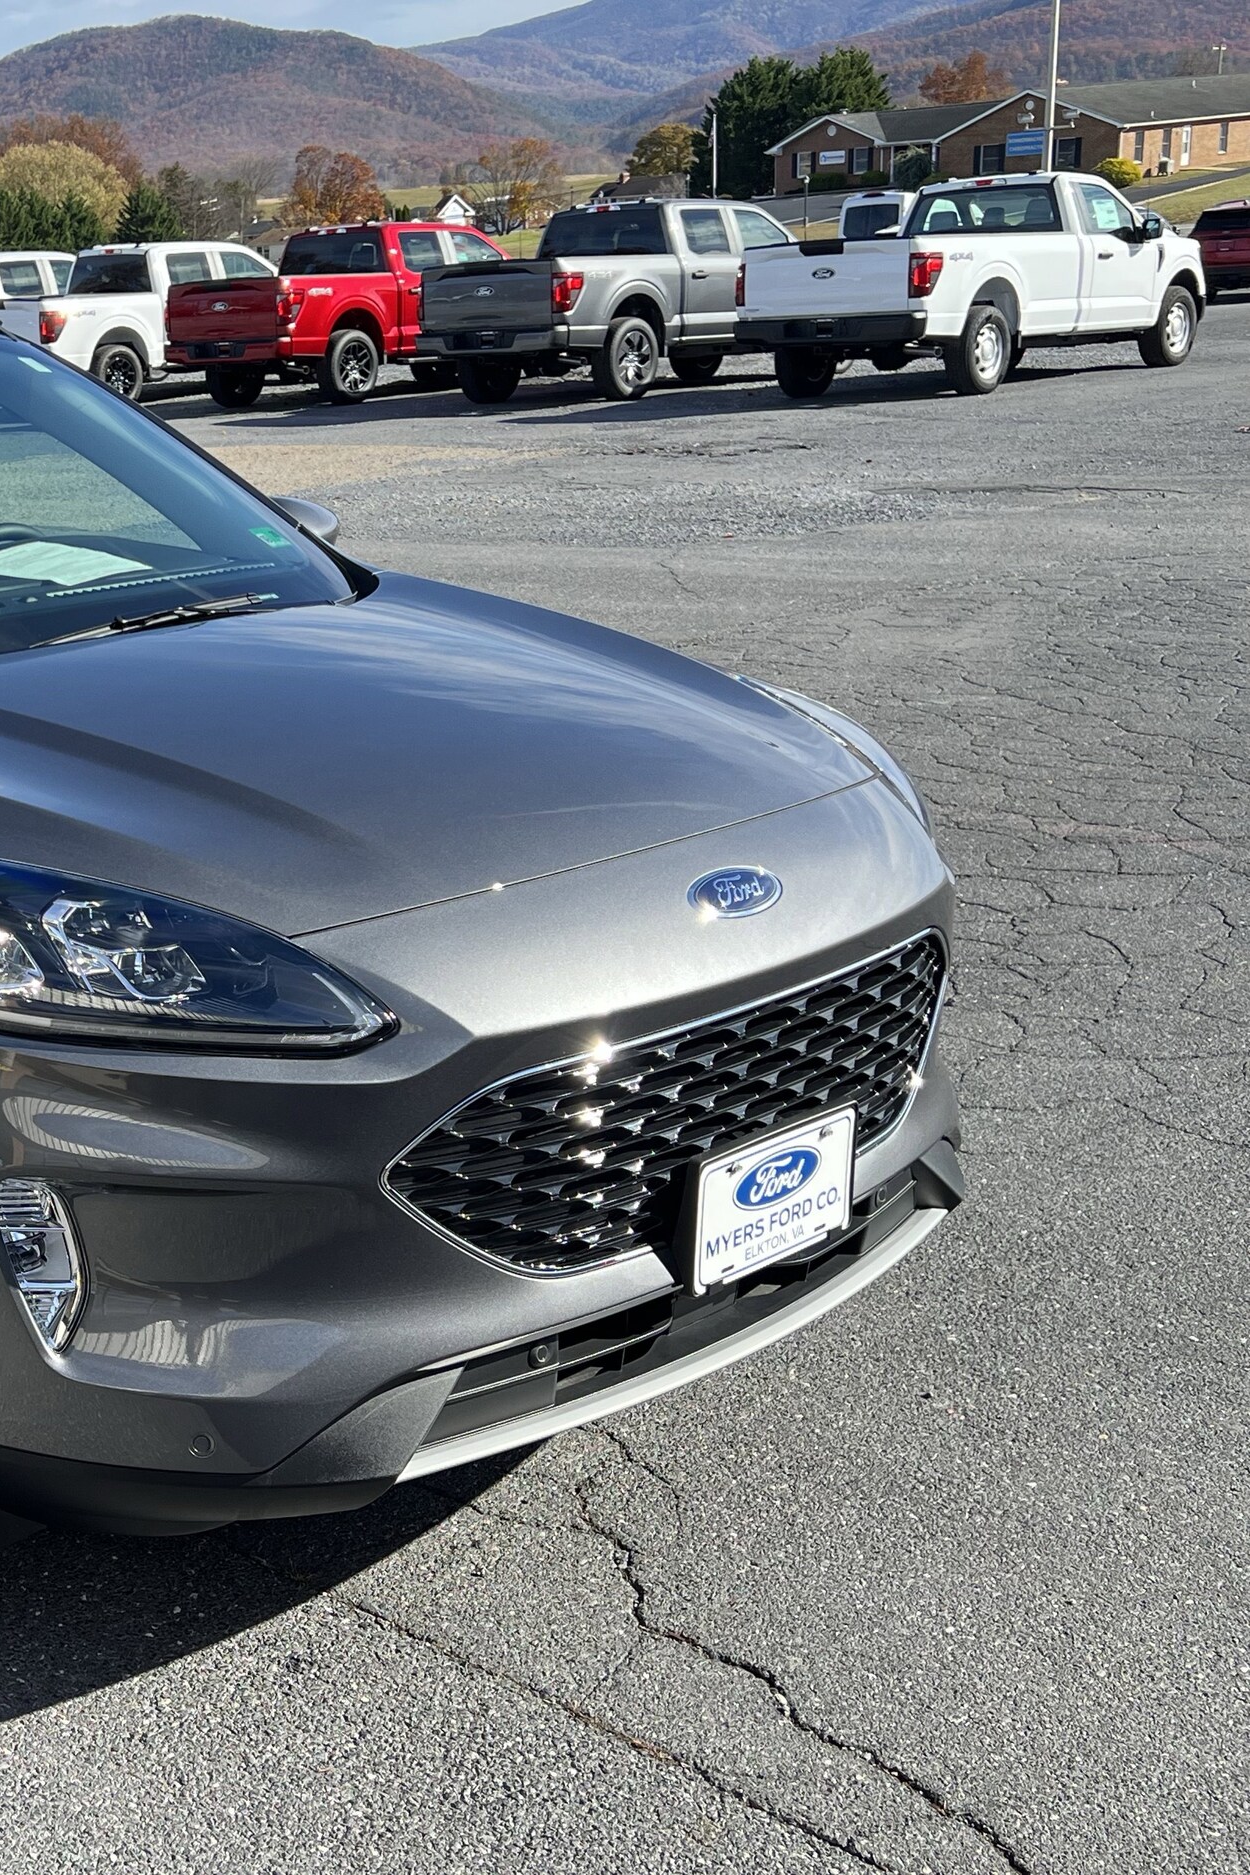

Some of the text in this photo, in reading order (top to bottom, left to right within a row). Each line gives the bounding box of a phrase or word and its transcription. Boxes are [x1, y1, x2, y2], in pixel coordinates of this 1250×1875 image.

[713, 874, 764, 909] Ford
[750, 1155, 806, 1204] Ford
[705, 1186, 841, 1260] MYERS FORD CO.
[744, 1225, 805, 1261] ELKTON, VA
